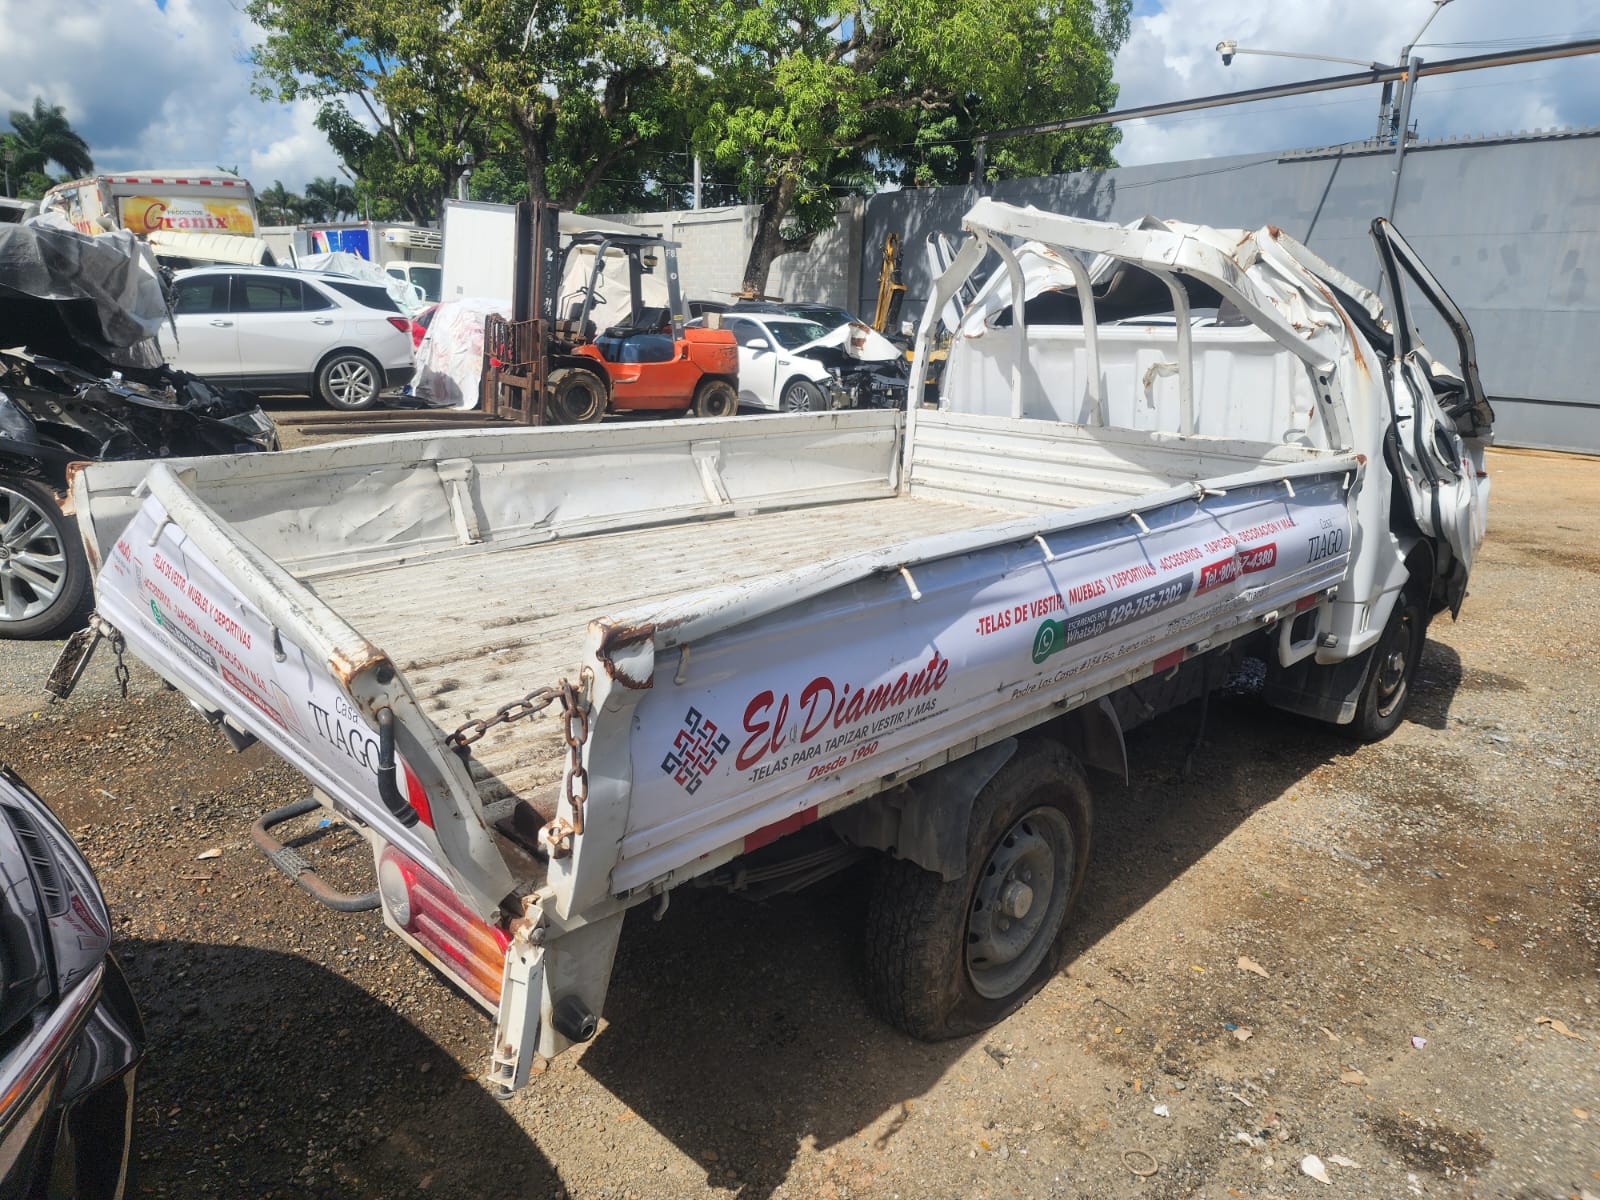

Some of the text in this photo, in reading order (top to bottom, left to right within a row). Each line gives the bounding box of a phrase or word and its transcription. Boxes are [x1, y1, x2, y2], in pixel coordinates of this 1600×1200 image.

[144, 203, 228, 230] Granix
[1307, 528, 1343, 563] TIAGO
[187, 583, 209, 614] MUEBLES
[214, 607, 252, 651] DEPORTIVAS
[976, 610, 1011, 637] -TELAS
[1014, 604, 1028, 625] DE
[1068, 579, 1107, 606] MUEBLES
[1106, 575, 1114, 591] Y
[1113, 562, 1157, 589] DEPORTIVAS
[1108, 582, 1183, 626] 829-755-7302
[1067, 620, 1106, 644] WhatsApp
[335, 696, 359, 723] Casa
[736, 650, 949, 771] El Diamante
[307, 700, 381, 777] TIAGO
[748, 756, 789, 784] -TELAS
[790, 743, 822, 767] PARA
[824, 726, 869, 753] TAPIZAR
[871, 711, 905, 734] VESTIR
[906, 707, 914, 720] Y
[807, 740, 880, 780] Desde 1960
